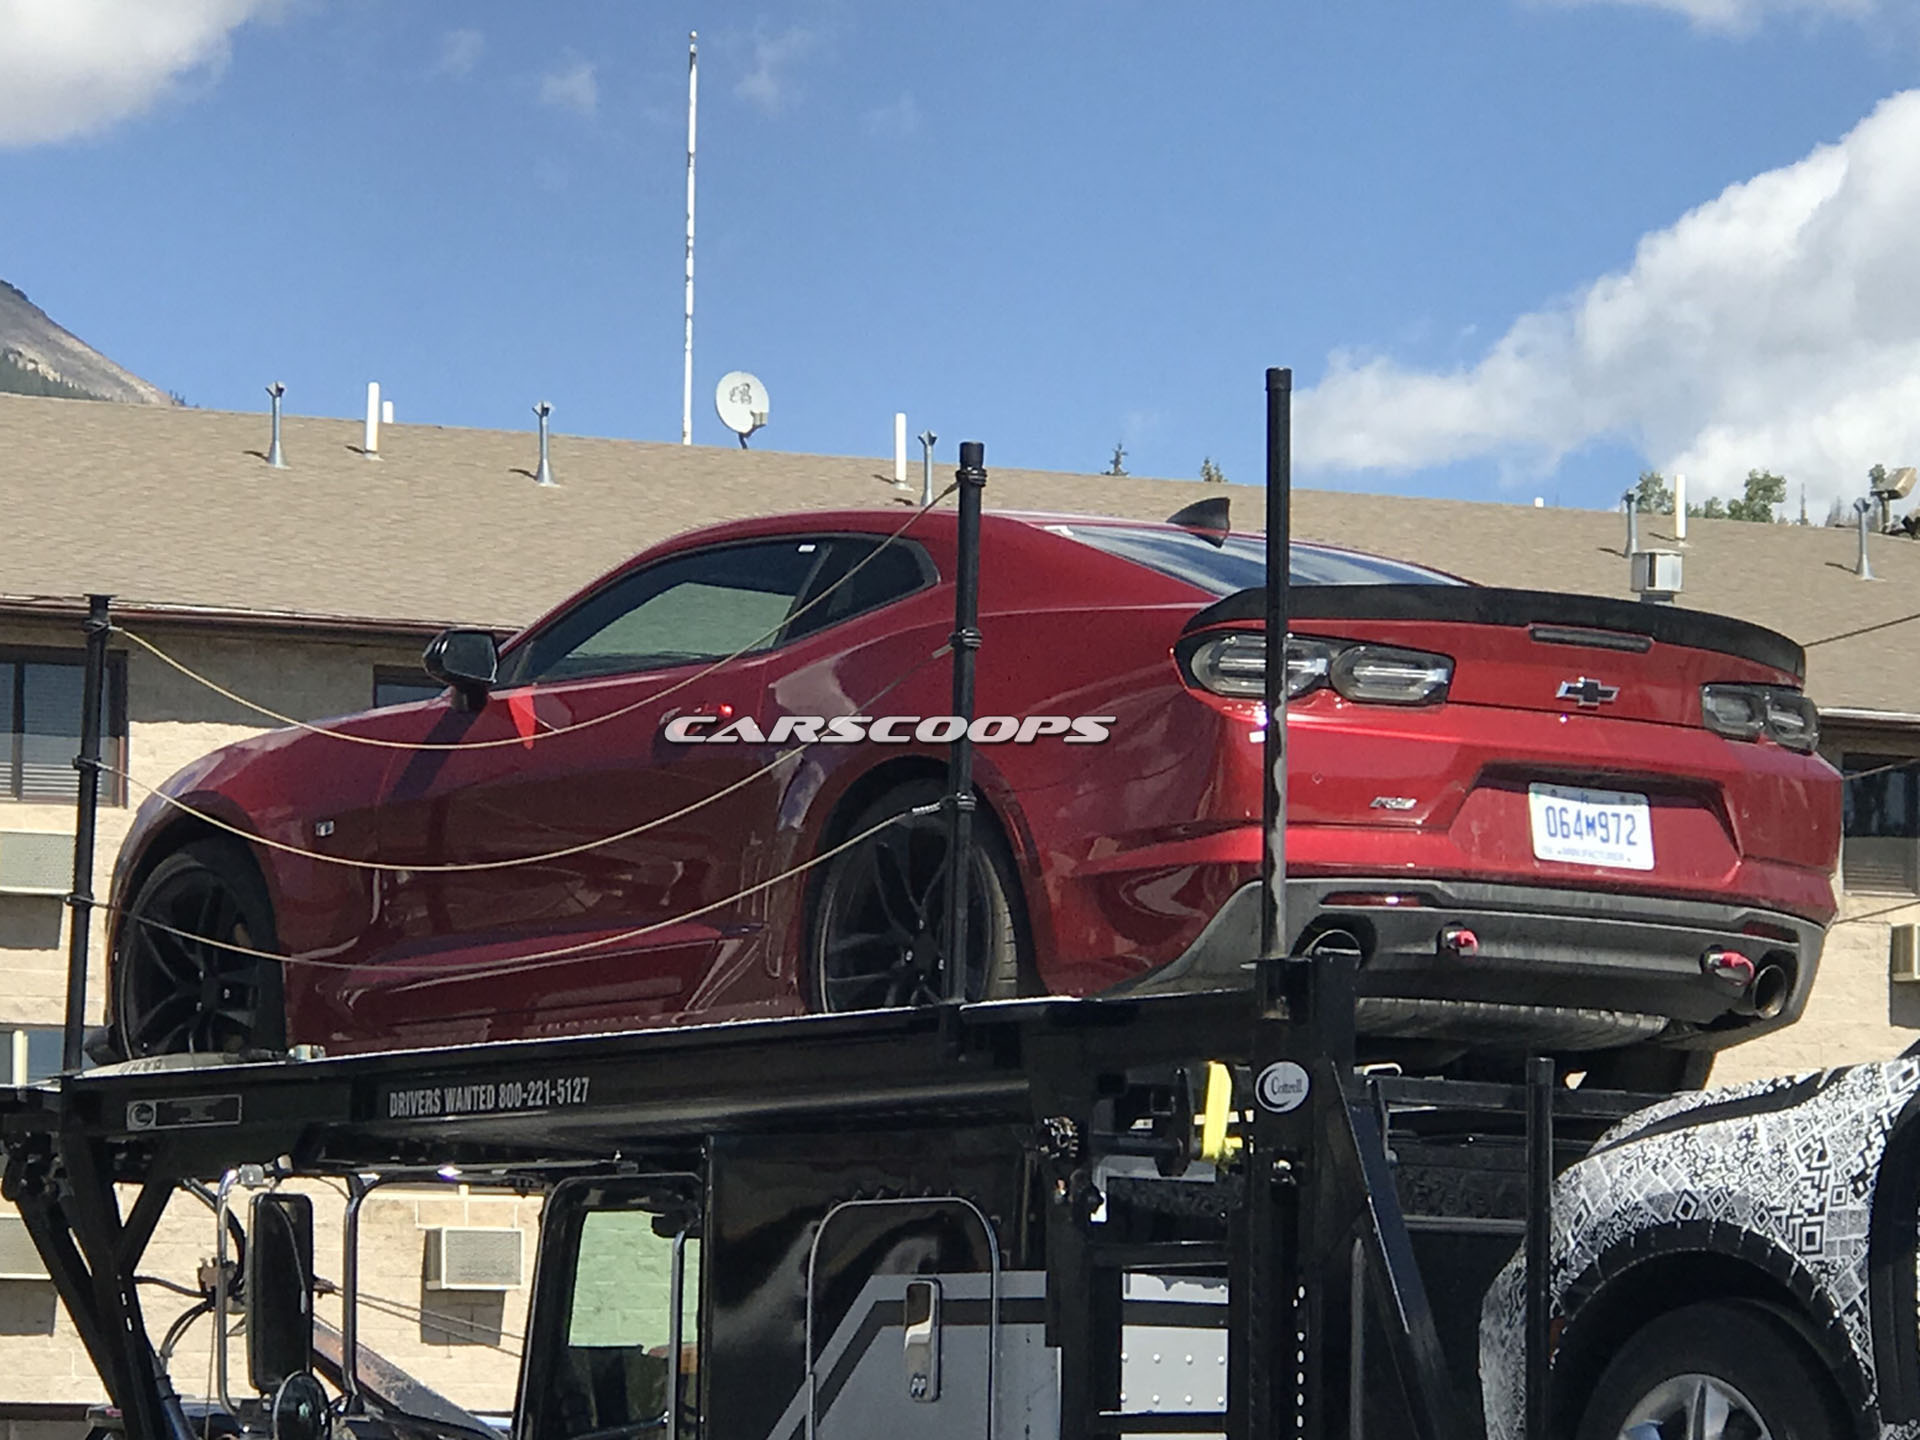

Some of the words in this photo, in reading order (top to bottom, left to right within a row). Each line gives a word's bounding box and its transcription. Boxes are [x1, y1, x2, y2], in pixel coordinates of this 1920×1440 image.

[1545, 805, 1638, 846] 064M972
[389, 1088, 441, 1117] DRIVERS
[444, 1083, 495, 1113] WANTED
[498, 1076, 590, 1109] 800-221-5127
